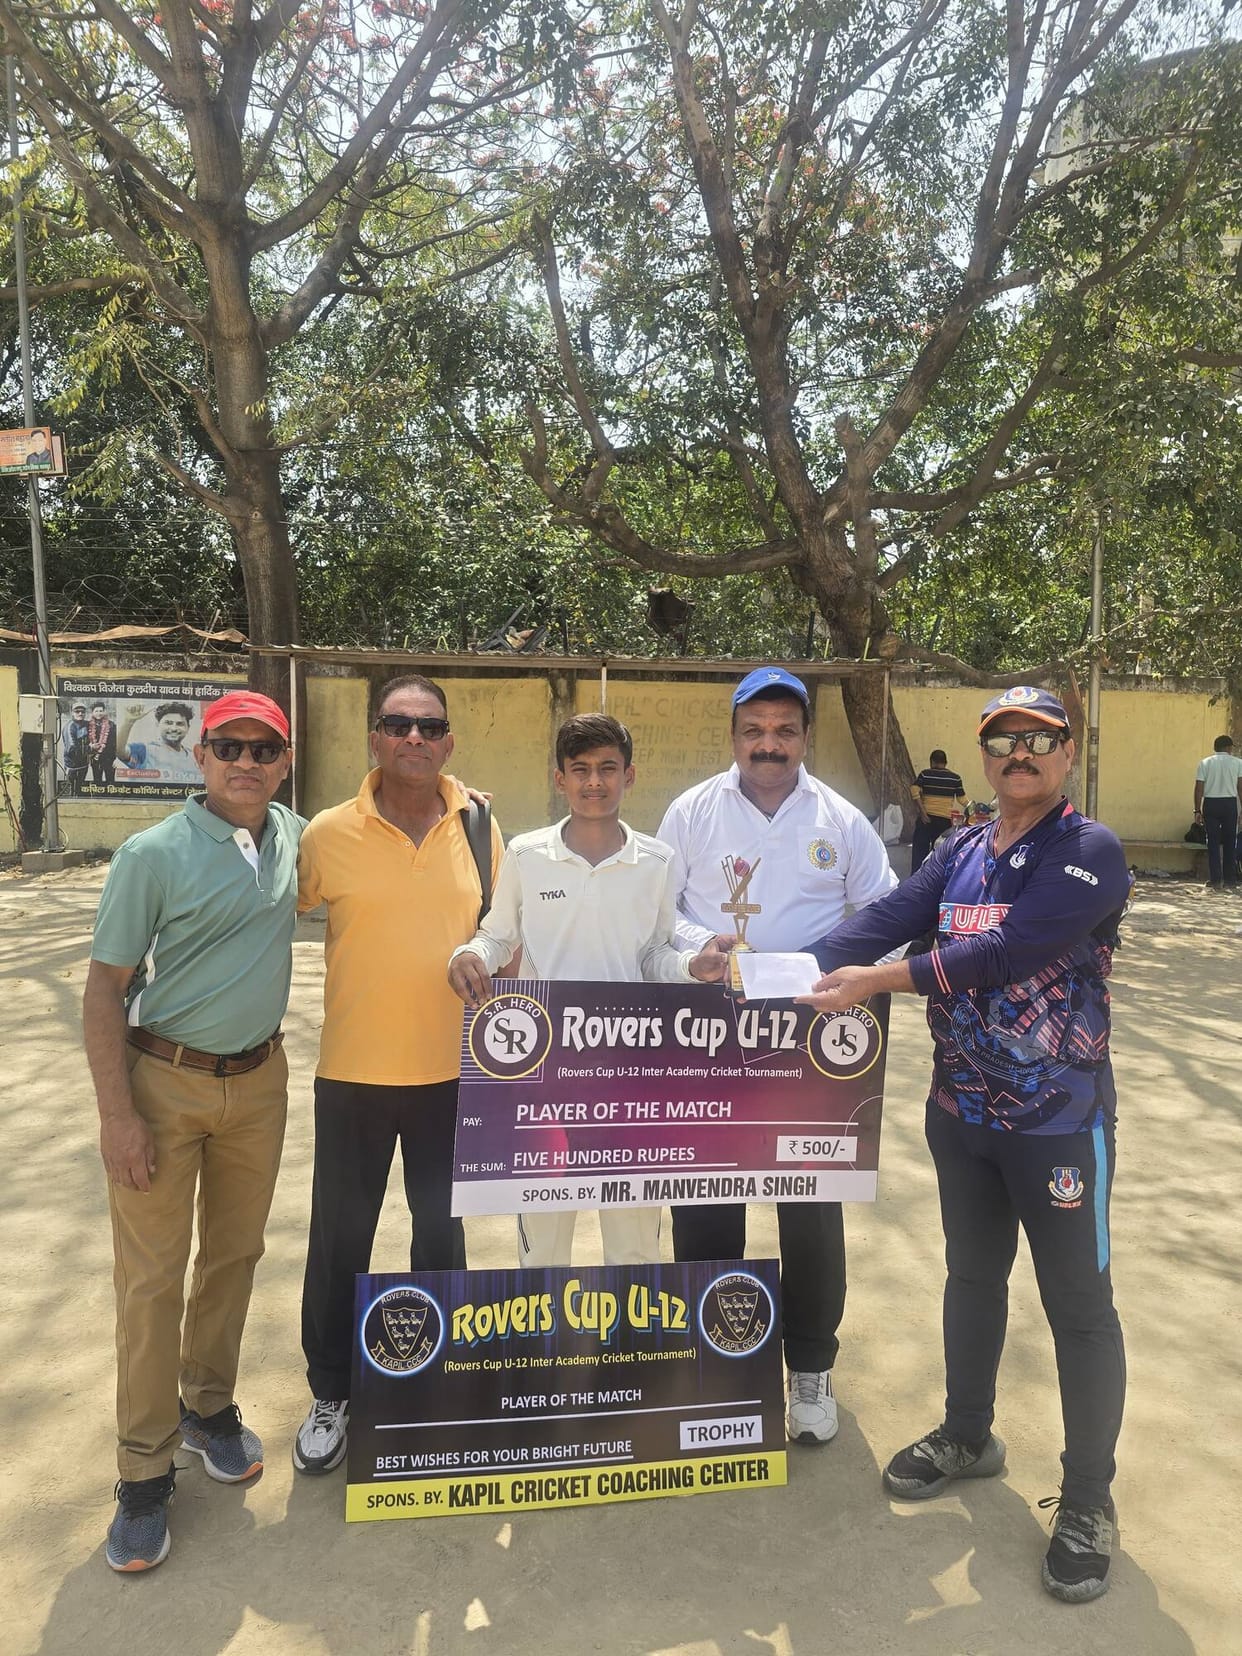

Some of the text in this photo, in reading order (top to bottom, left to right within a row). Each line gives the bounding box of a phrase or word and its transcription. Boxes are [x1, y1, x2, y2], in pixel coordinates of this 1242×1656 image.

[126, 682, 157, 696] कुलदीप
[159, 686, 180, 695] यादव
[540, 890, 566, 900] TYKA
[484, 998, 541, 1018] S.R. HERO
[844, 1007, 874, 1028] HERO
[493, 1017, 528, 1054] SR
[561, 1006, 798, 1057] Rovers Cup U-12
[832, 1024, 857, 1056] JS
[557, 1067, 803, 1079] (Rovers Cup U-12 Inter Academy Cricket Tournament)
[516, 1101, 732, 1122] PLAYER OF THE MATCH
[463, 1117, 482, 1127] PAY:
[513, 1147, 695, 1167] FIVE HUNDRED RUPEES
[802, 1139, 845, 1158] 500/-
[460, 1162, 506, 1173] THE SUM:
[522, 1175, 817, 1203] SPONS. BY. MR. MANVENDRA SINGH
[715, 1276, 760, 1289] ROVERS CLUB
[381, 1291, 429, 1304] ROVERS CLUB
[452, 1279, 689, 1346] Rovers Cup U-12
[444, 1347, 696, 1373] (Rovers Cup U-12 Inter Academy Cricket Tournament)
[501, 1389, 642, 1410] PLAYER OF THE MATCH
[687, 1422, 755, 1442] TROPHY
[376, 1440, 632, 1469] BEST WISHES FOR YOUR BRIGHT FUTURE
[367, 1458, 769, 1509] SPONS. BY. KAPIL CRICKET COACHING CENTER
